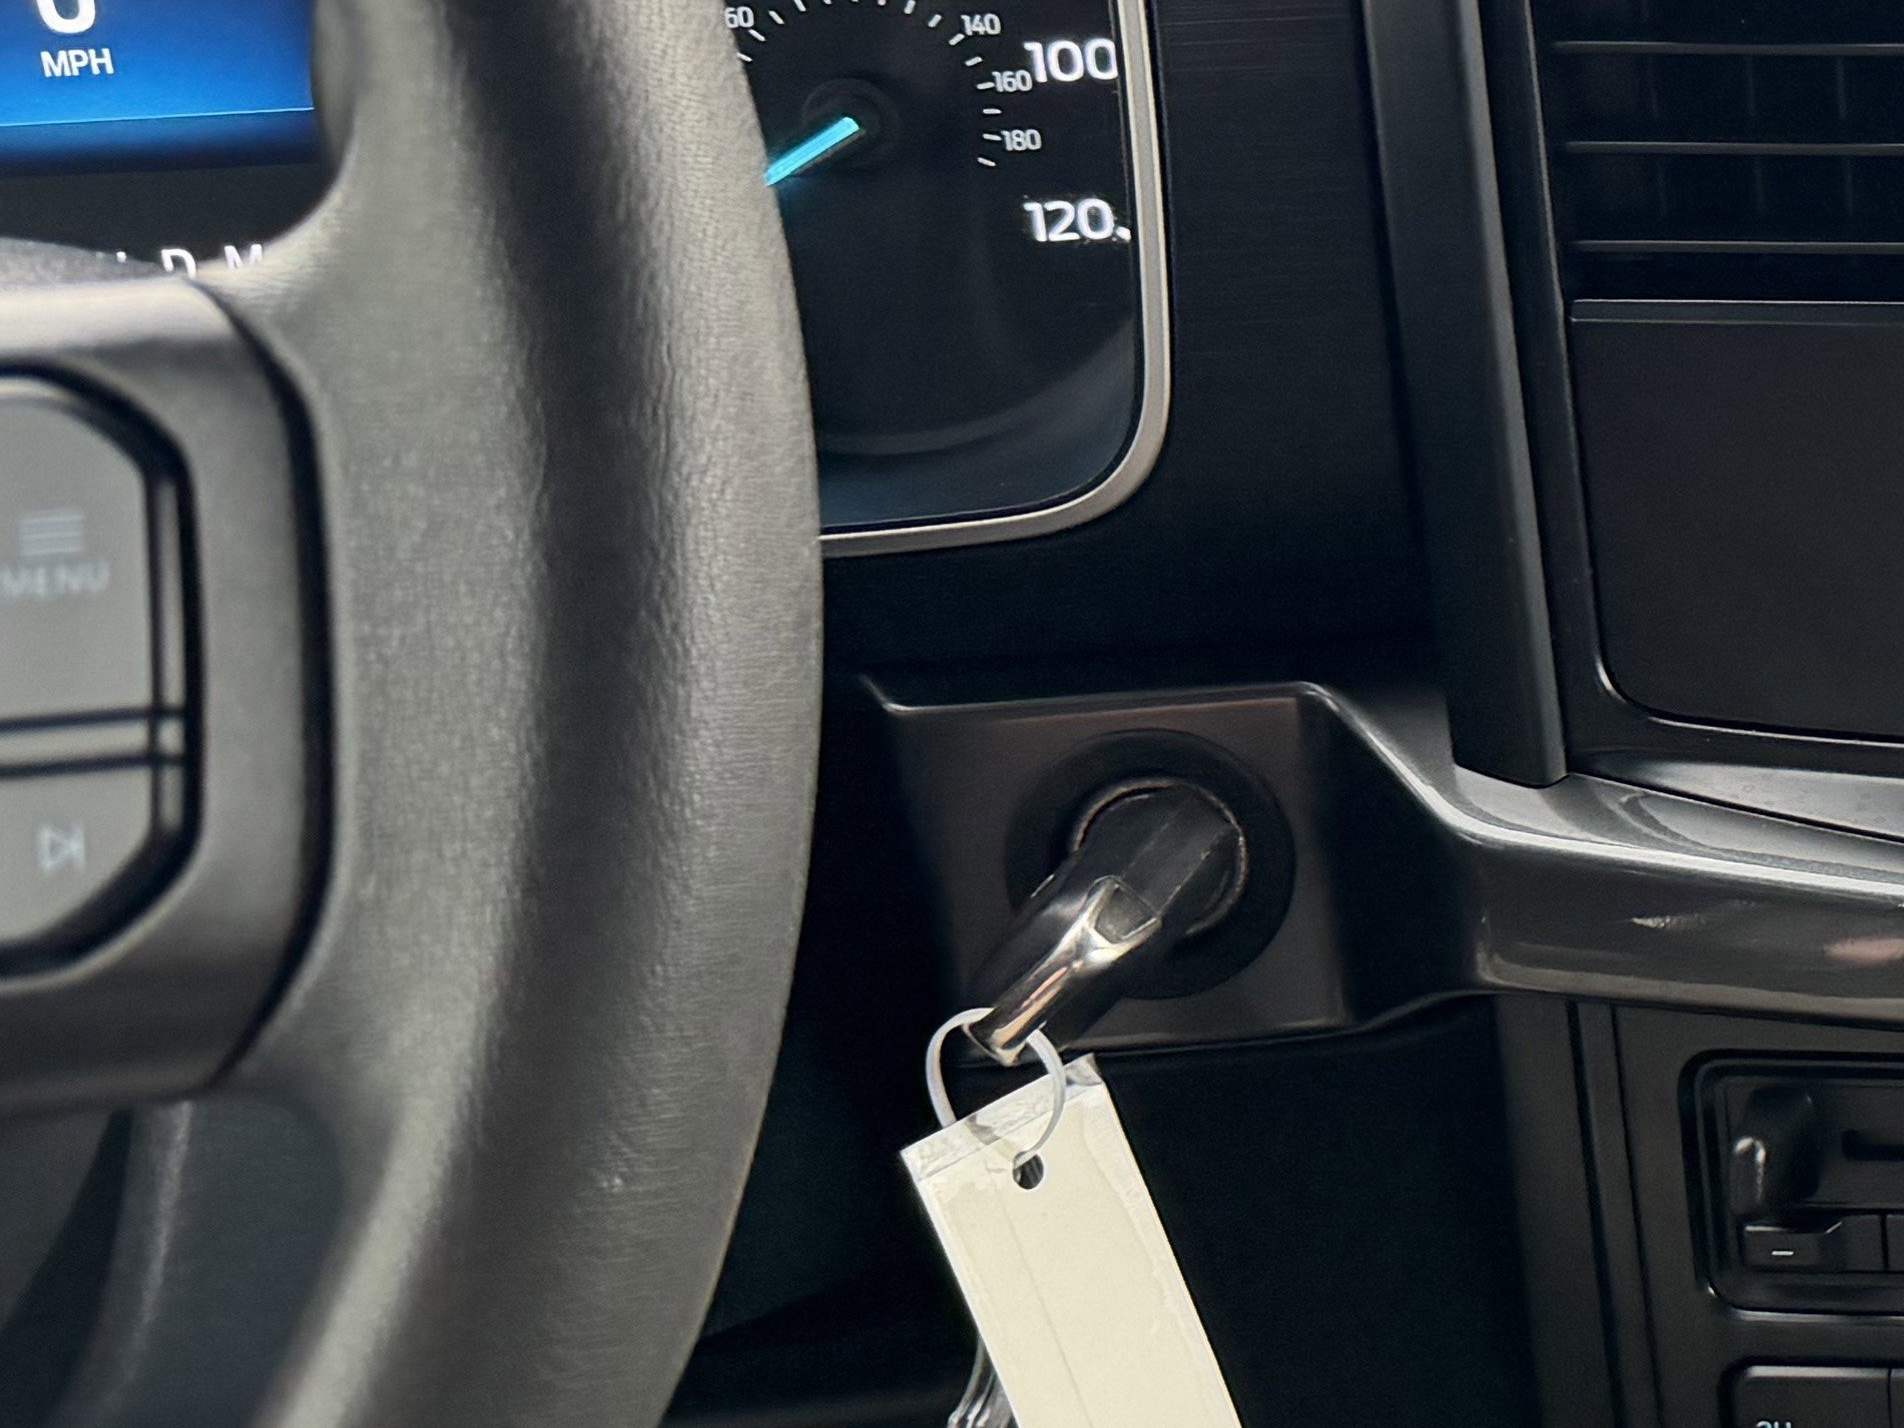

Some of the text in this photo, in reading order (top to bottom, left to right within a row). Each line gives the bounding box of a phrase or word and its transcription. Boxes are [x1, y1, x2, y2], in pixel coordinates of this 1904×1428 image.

[724, 6, 755, 32] 60
[960, 12, 1002, 38] 140
[40, 47, 114, 78] MPH
[1023, 37, 1117, 84] 100
[992, 68, 1033, 93] 160
[1001, 128, 1042, 152] 180
[1023, 197, 1116, 243] 120
